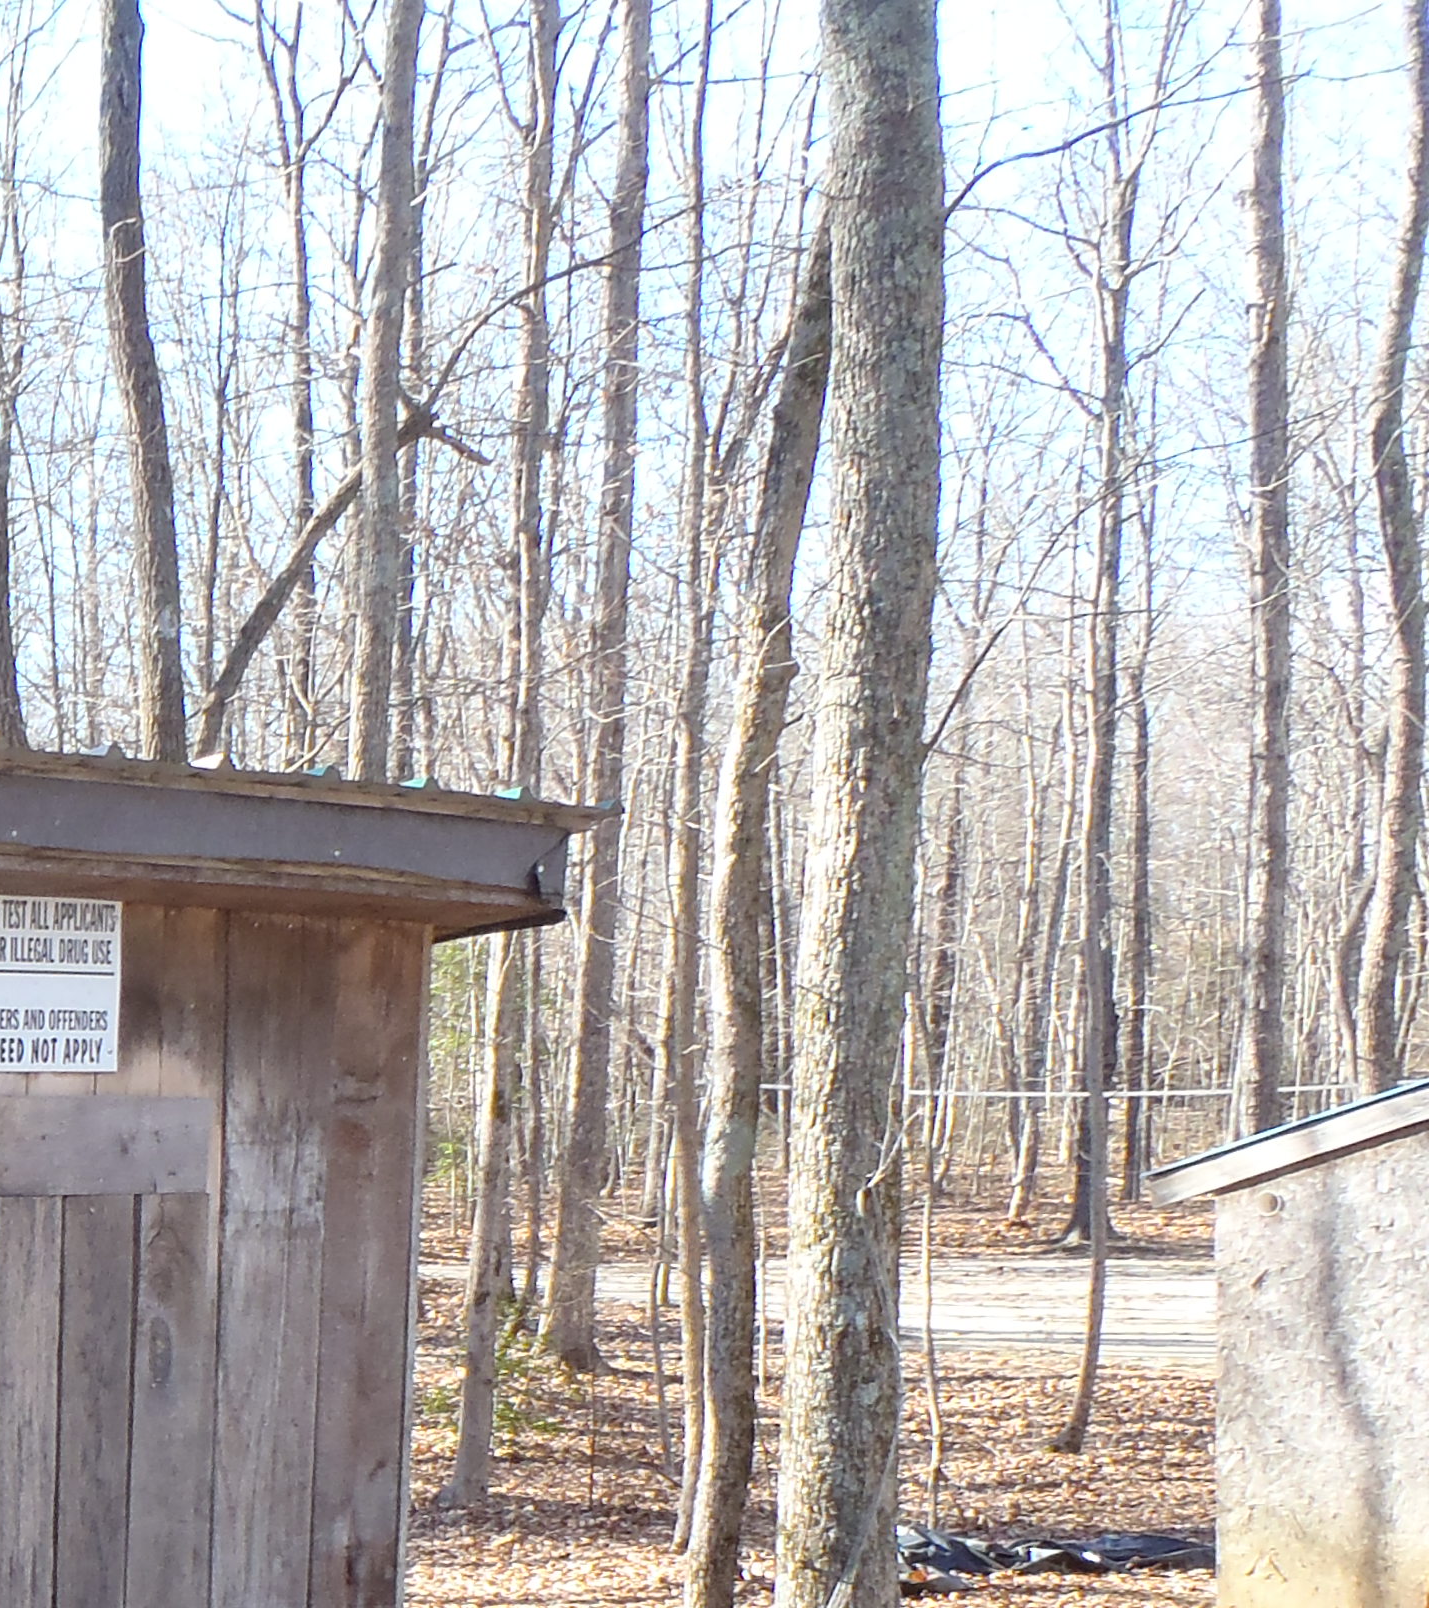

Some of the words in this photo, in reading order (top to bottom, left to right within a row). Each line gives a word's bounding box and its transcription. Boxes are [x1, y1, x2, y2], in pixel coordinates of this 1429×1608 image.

[2, 900, 27, 929] TEST
[30, 902, 49, 931] ALL
[52, 902, 116, 933] APPLICANTS
[10, 937, 54, 963] ILLEGAL
[58, 939, 89, 964] DRUG
[92, 940, 112, 965] USE
[22, 1009, 45, 1030] AND
[48, 1010, 108, 1032] OFFENDERS
[31, 1037, 58, 1064] NOT
[62, 1038, 103, 1065] APPLY
